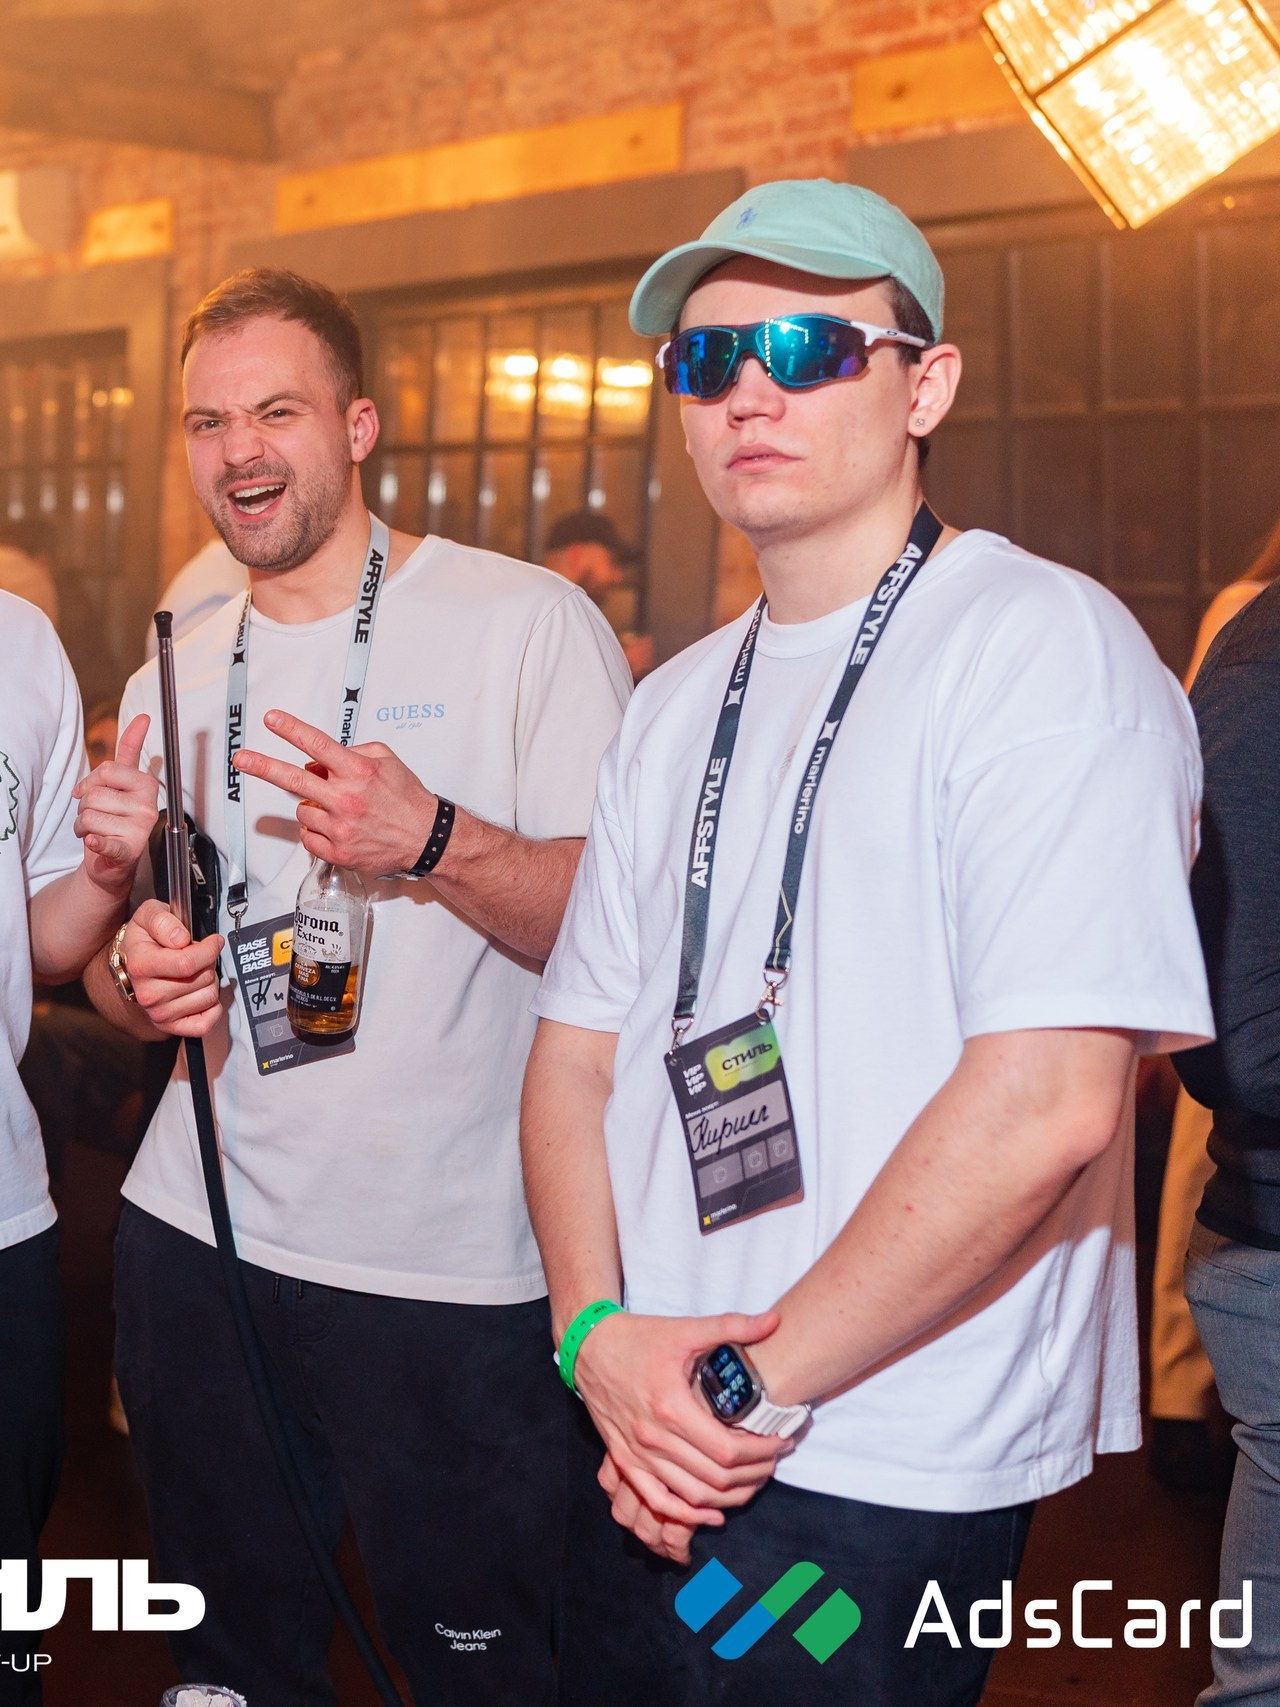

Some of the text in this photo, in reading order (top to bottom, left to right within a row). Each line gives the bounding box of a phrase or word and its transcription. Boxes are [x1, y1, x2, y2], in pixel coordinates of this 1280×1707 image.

[354, 548, 384, 644] AFFSTYLE
[850, 542, 923, 667] AFFSTYLE
[733, 609, 762, 683] marlerino
[376, 703, 445, 722] GUESS
[340, 708, 354, 747] marle
[794, 746, 827, 834] marlerino
[691, 757, 727, 888] AFFSTYLE
[295, 905, 339, 933] Corona
[296, 923, 325, 945] Extra
[237, 937, 268, 955] BASE
[239, 948, 270, 965] BASE
[242, 957, 272, 975] BASE
[722, 1042, 773, 1071] СТИЛЬ
[683, 1063, 702, 1078] VIP
[686, 1073, 704, 1087] VIP
[688, 1081, 707, 1096] VIP
[434, 1622, 501, 1640] Calvin Klein
[450, 1640, 487, 1651] Jeans
